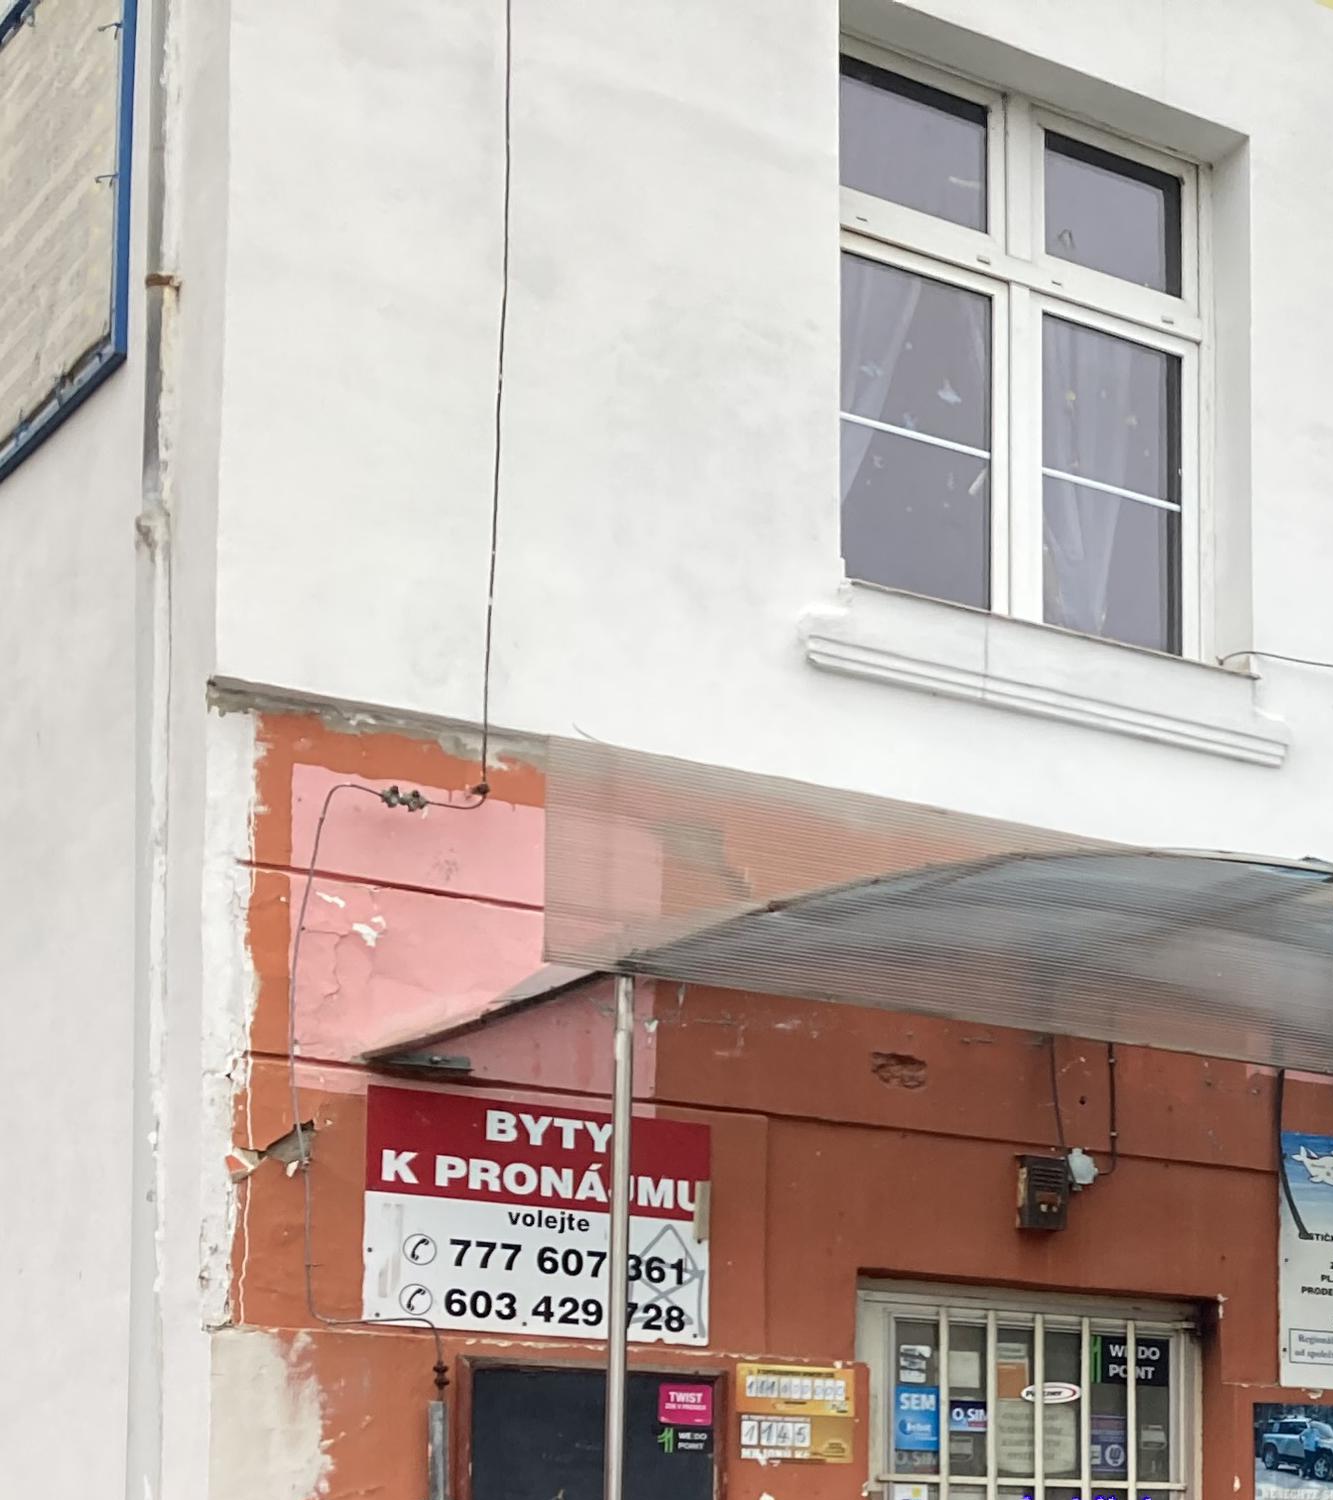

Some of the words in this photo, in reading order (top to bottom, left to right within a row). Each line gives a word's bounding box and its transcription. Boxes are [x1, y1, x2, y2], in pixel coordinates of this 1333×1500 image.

[486, 1109, 613, 1153] BYTY
[381, 1149, 419, 1184] K
[508, 1210, 590, 1233] volejte
[450, 1238, 522, 1271] 777
[537, 1247, 607, 1278] 607
[628, 1254, 683, 1285] 361
[444, 1289, 517, 1320] 603
[532, 1296, 603, 1326] 429
[1109, 1364, 1155, 1379] PONT
[669, 1391, 703, 1403] TWIST
[900, 1393, 936, 1411] SEM
